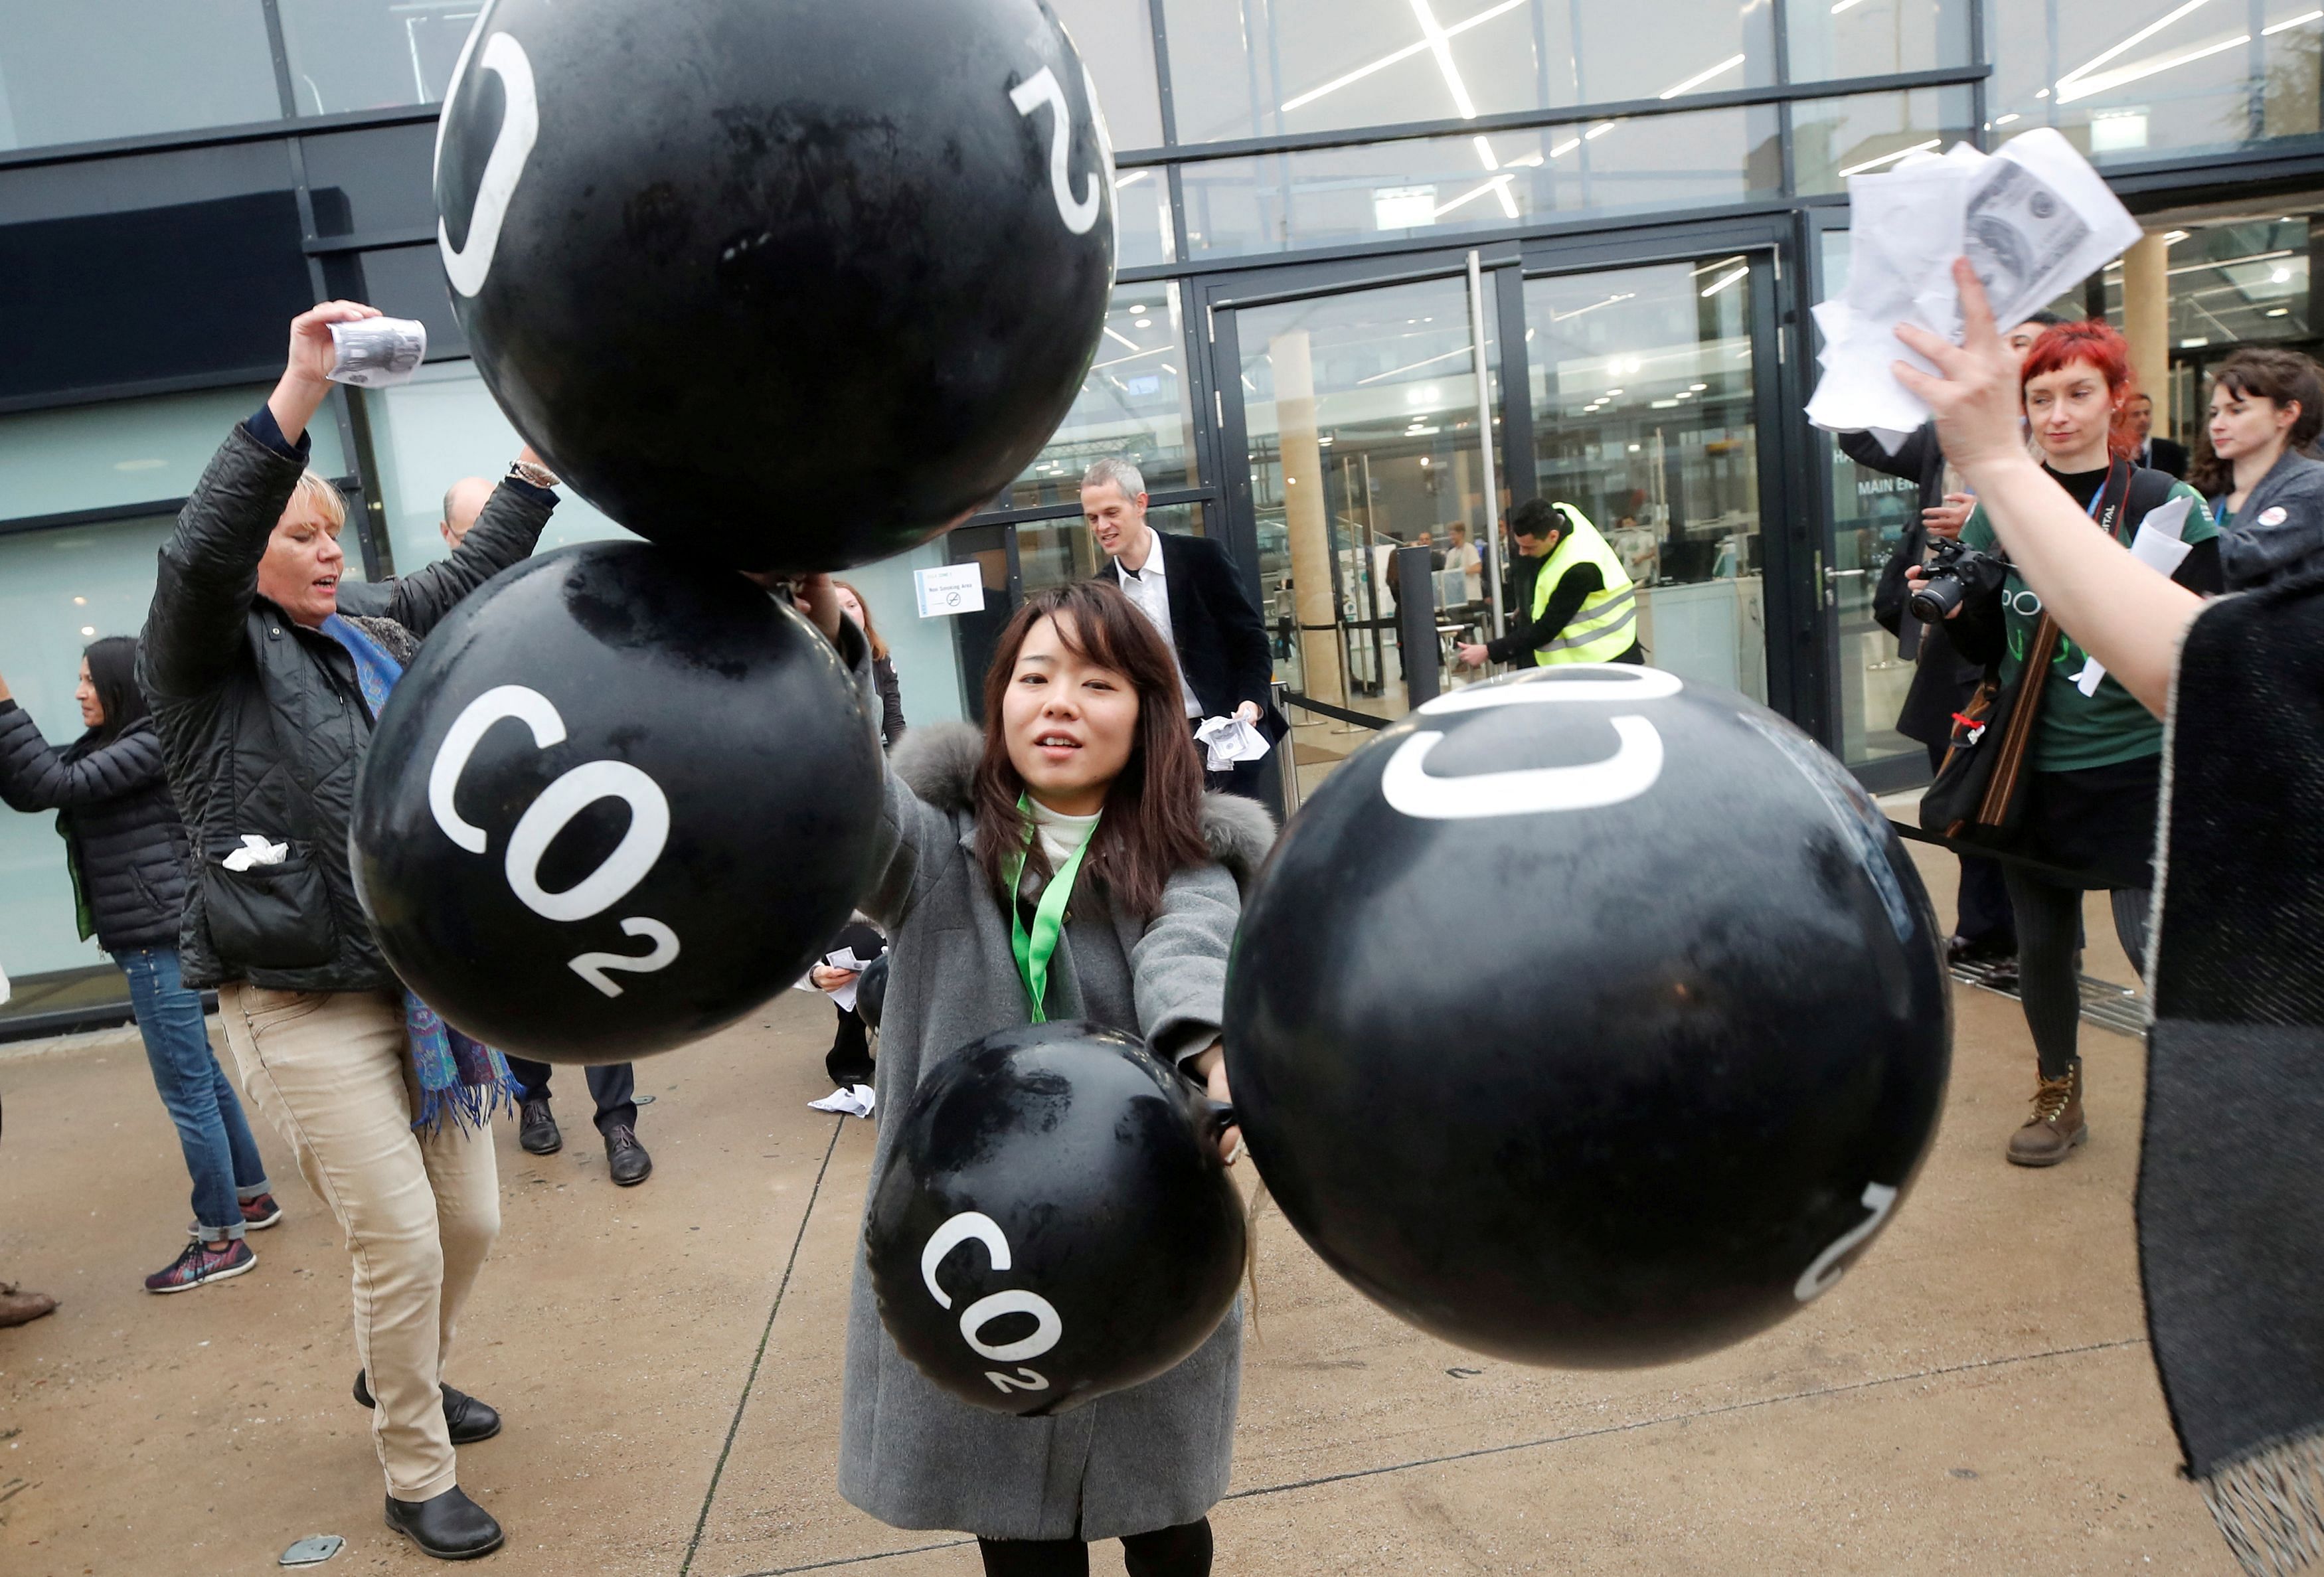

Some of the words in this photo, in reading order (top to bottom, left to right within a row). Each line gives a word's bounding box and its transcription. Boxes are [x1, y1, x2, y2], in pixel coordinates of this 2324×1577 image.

[1858, 478, 1893, 495] MAIN
[428, 684, 681, 998] CO2
[920, 1211, 1062, 1394] CO2
